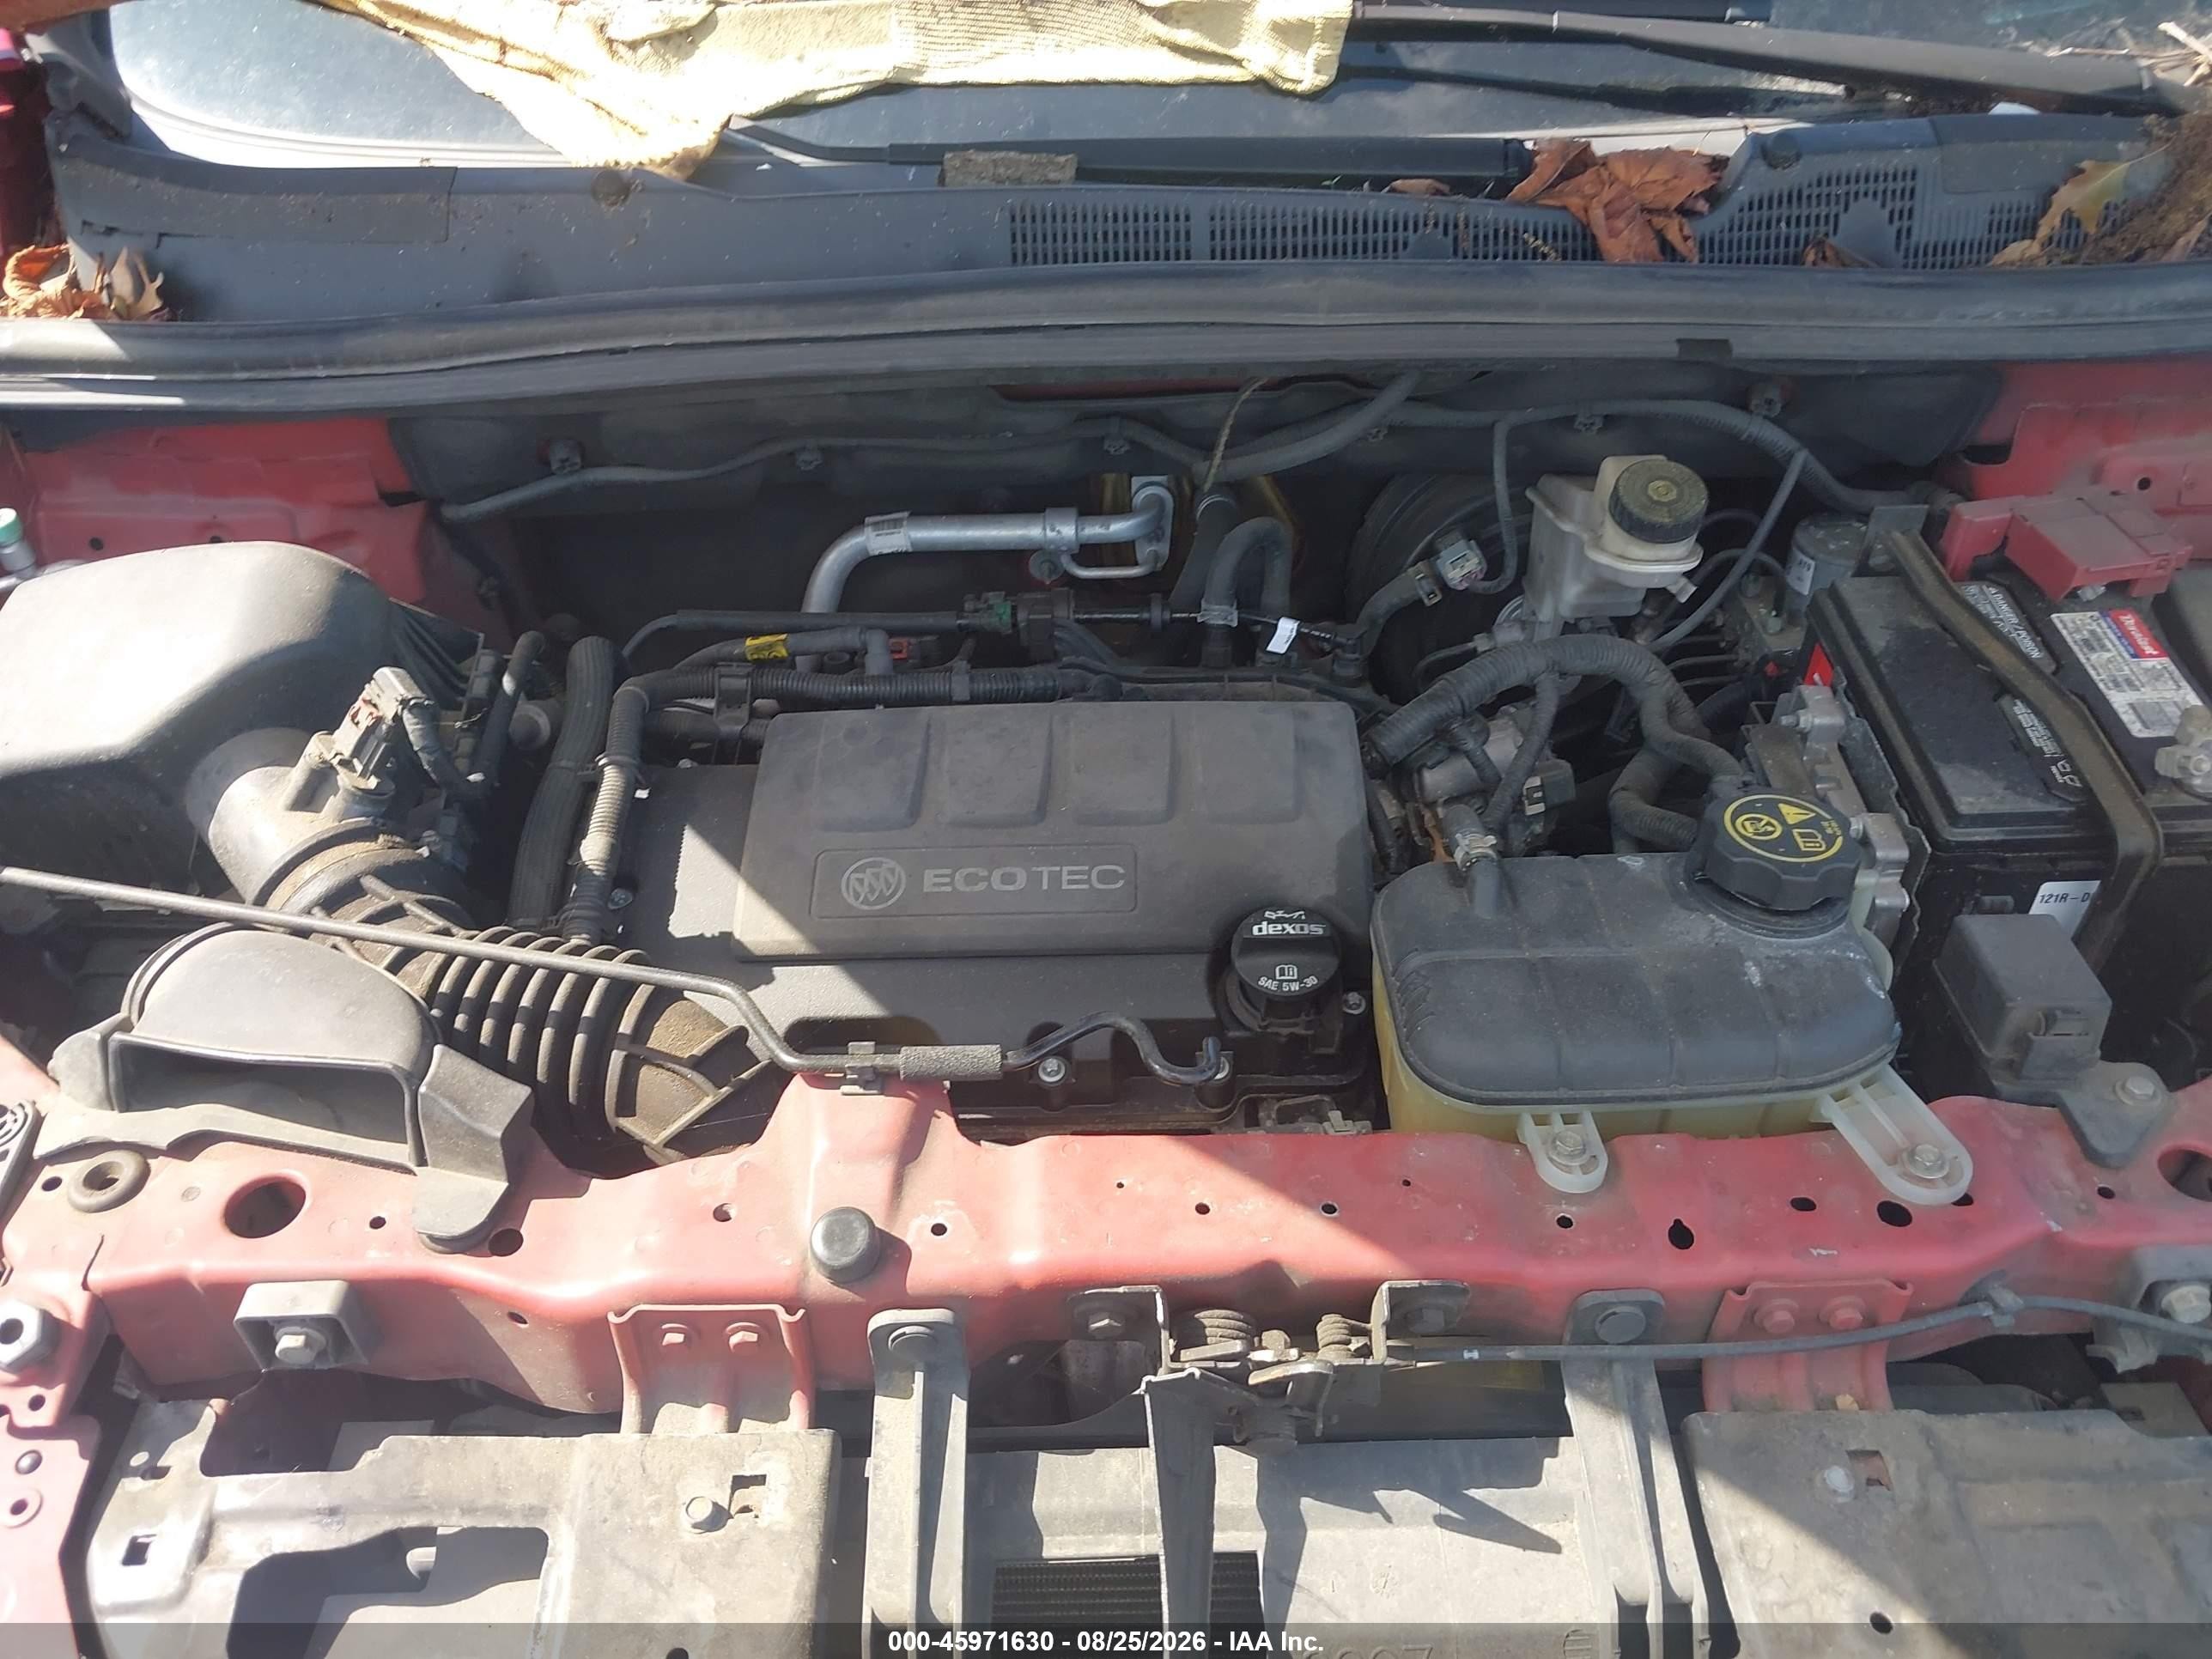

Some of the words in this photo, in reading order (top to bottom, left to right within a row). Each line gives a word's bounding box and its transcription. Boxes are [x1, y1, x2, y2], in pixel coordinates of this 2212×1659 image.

[922, 864, 1127, 893] ECOTEC
[1252, 921, 1327, 936] dexos
[1257, 975, 1279, 991] SAE
[1281, 975, 1319, 992] 5W-30
